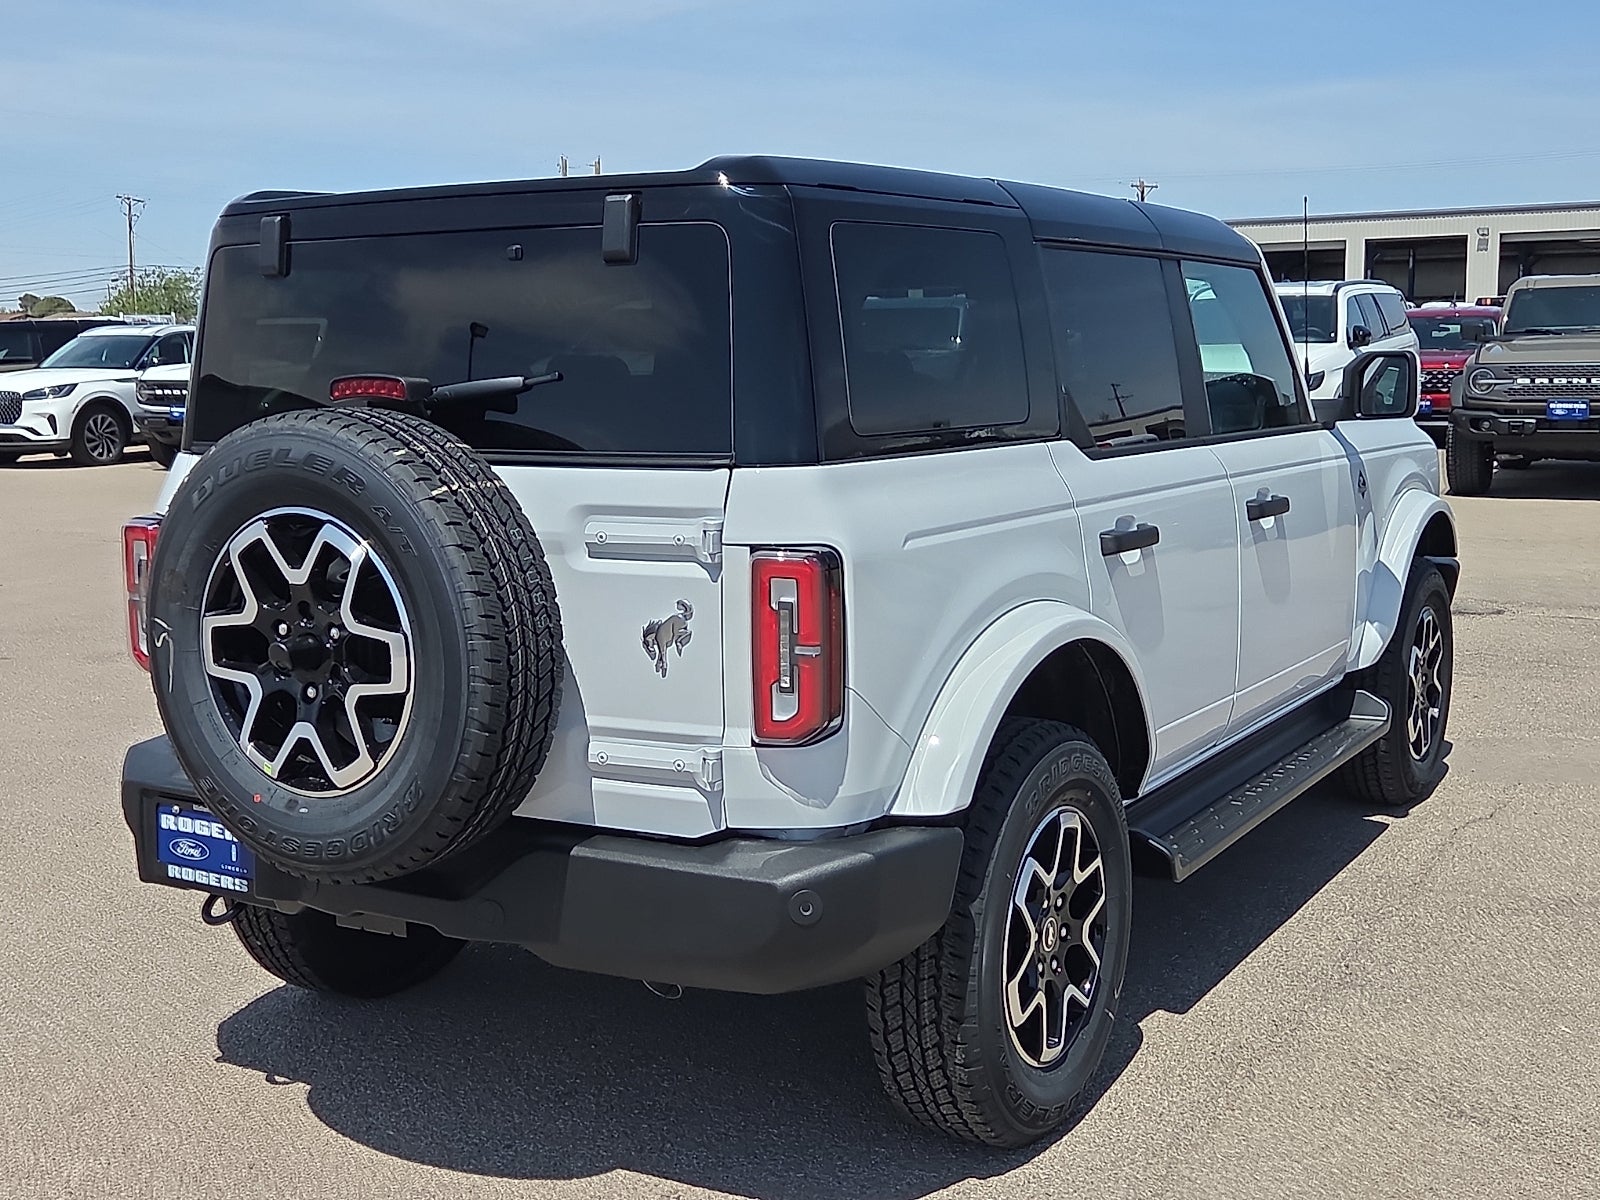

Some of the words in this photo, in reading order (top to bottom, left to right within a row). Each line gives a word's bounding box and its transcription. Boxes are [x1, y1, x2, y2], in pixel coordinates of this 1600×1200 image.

[192, 448, 367, 512] DUELER
[370, 505, 417, 556] A/T
[160, 813, 239, 842] ROGE
[200, 775, 424, 858] BRIDGESTONE
[167, 864, 249, 893] ROGERS
